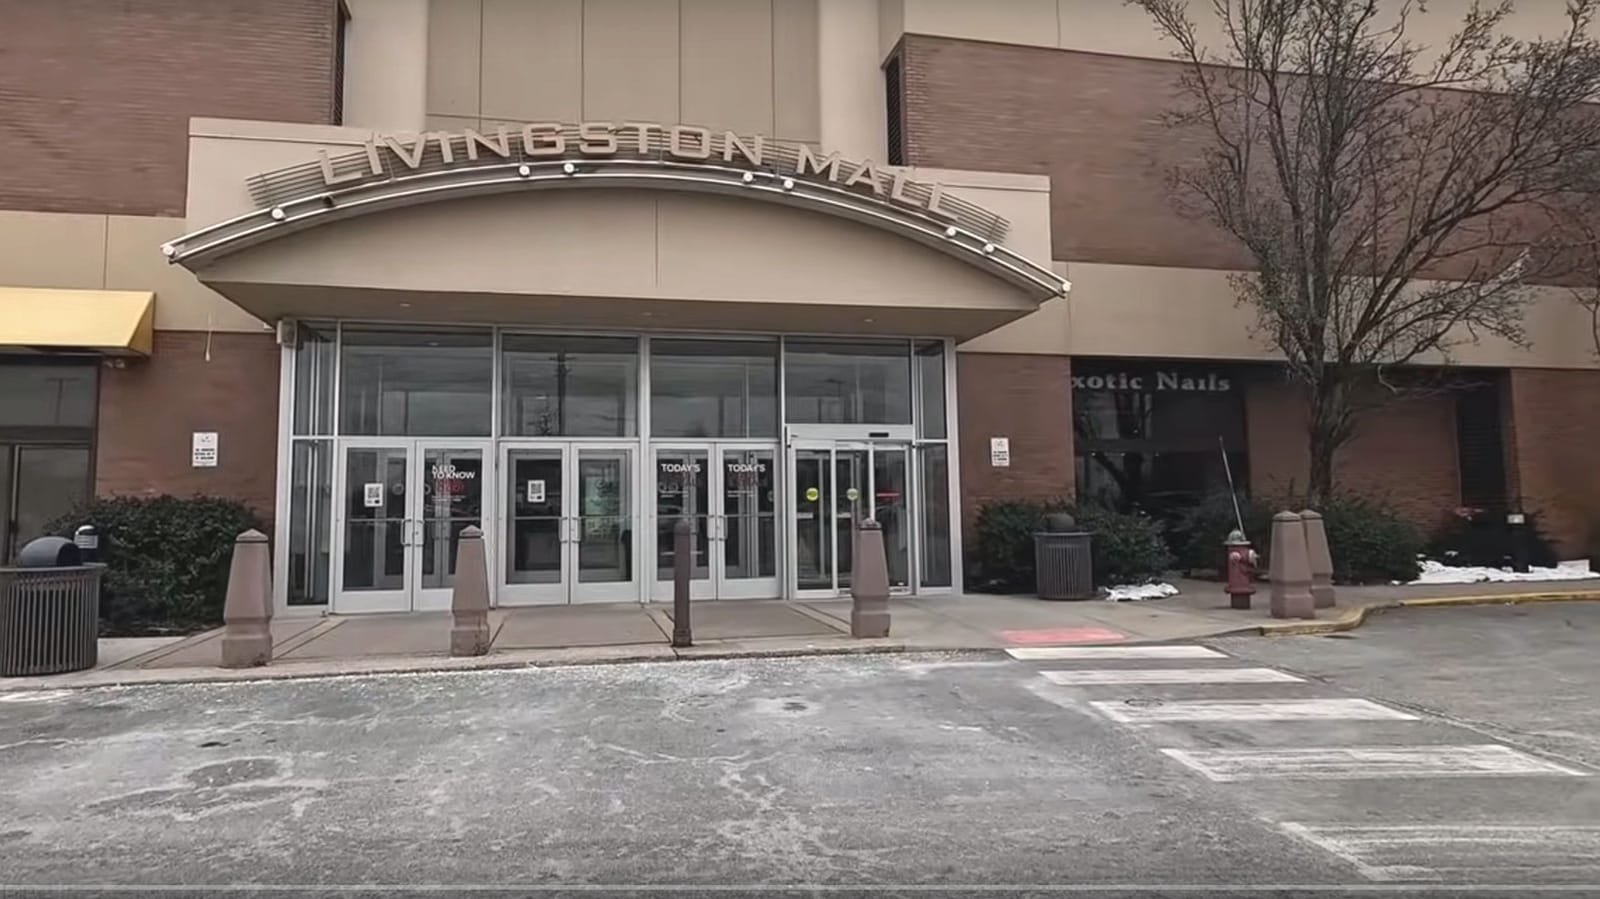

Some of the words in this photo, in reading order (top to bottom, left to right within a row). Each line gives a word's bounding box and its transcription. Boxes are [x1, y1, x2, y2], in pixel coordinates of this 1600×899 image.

[319, 122, 763, 186] LIVINGSTON
[796, 143, 958, 223] MALL
[1072, 372, 1143, 390] xotic
[1156, 371, 1231, 391] Nails
[661, 463, 701, 473] TODAY'S
[727, 463, 766, 473] TODAY'S
[432, 472, 445, 480] TO
[446, 471, 476, 480] KNOW
